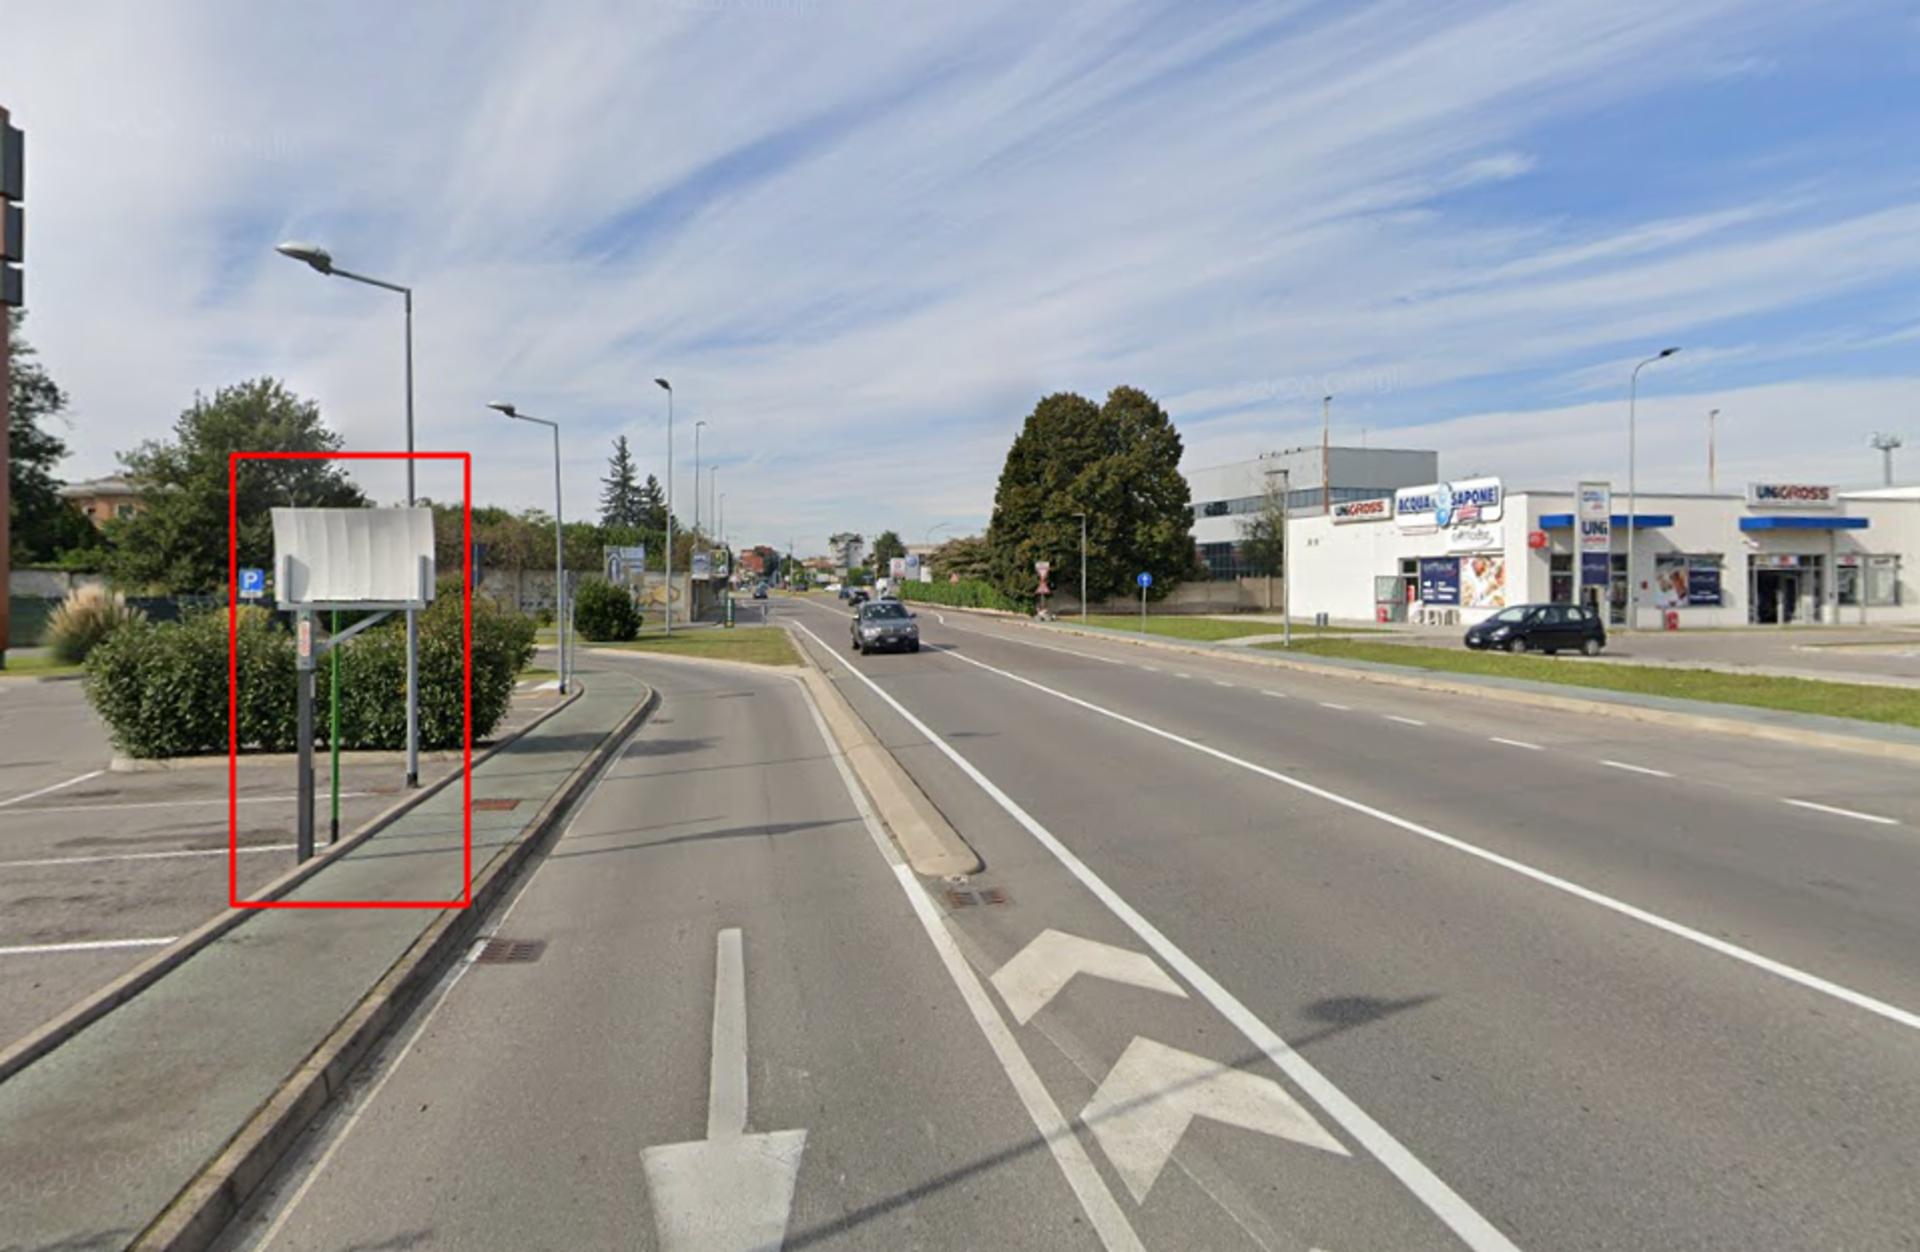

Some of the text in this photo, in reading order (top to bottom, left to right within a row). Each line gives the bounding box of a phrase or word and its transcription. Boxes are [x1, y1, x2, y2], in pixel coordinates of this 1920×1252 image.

[1399, 487, 1494, 511] ACQUA SAPONE
[244, 571, 258, 589] P
